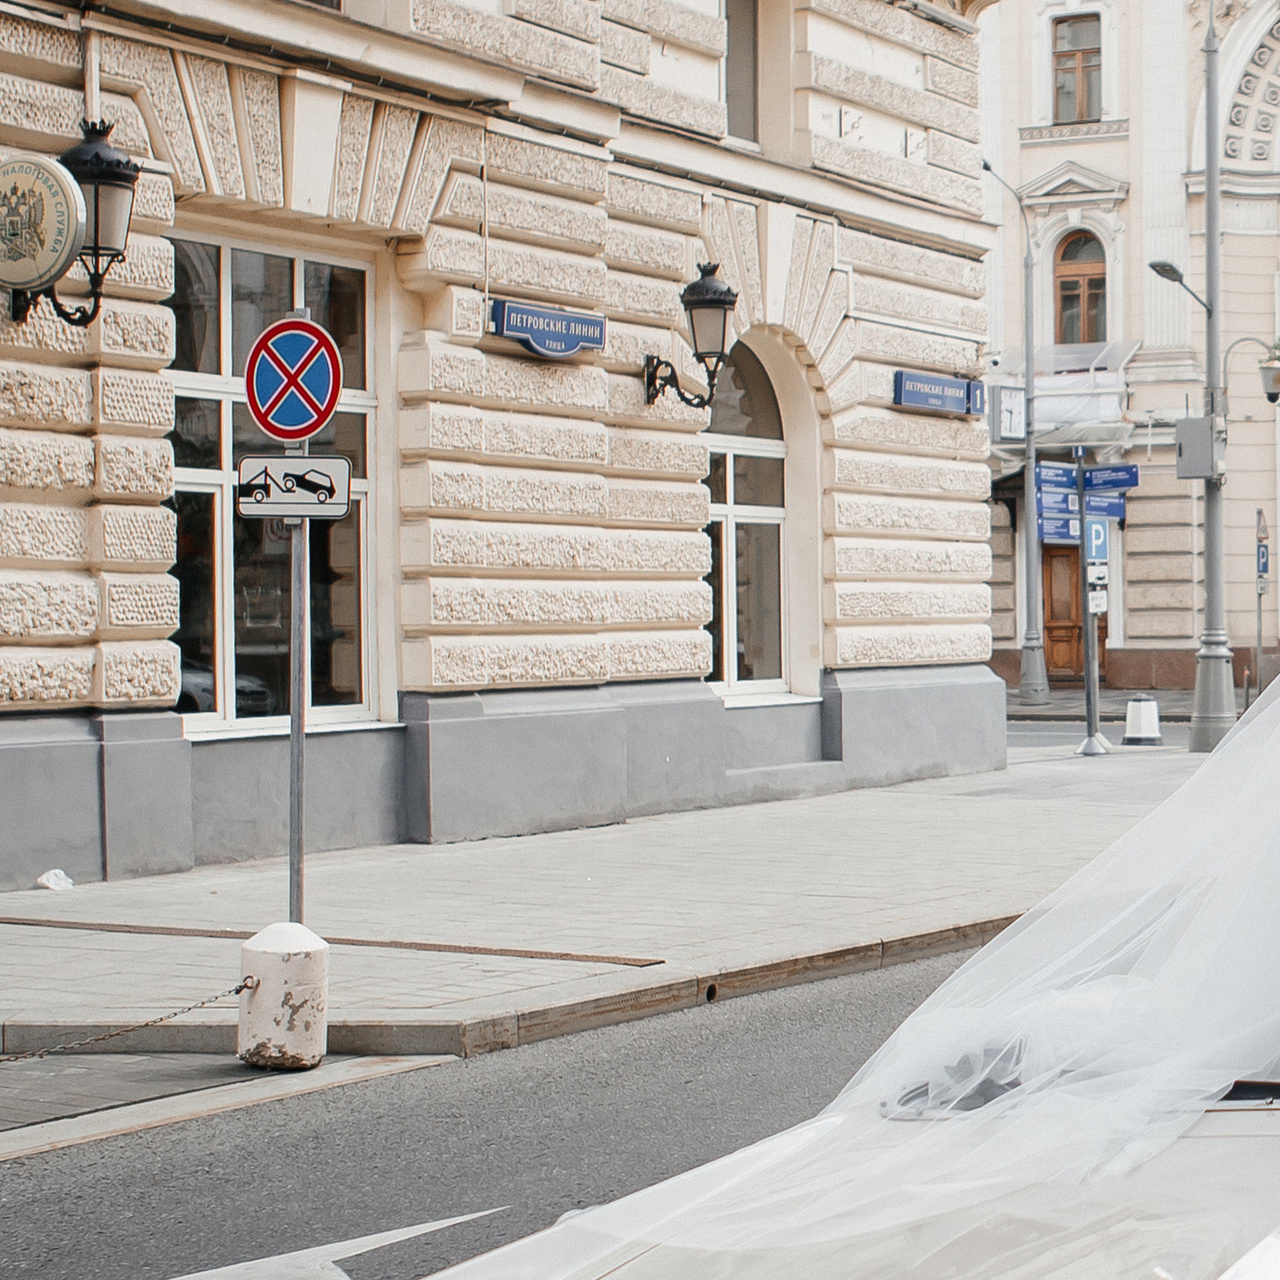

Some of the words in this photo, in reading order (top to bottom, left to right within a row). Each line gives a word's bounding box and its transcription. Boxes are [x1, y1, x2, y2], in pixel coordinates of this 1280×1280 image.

[2, 164, 60, 199] НАЛОГОВАЯ
[50, 201, 66, 254] СЛУЖБА
[510, 312, 567, 334] ПЕТРОВСКИЕ
[569, 322, 600, 339] ЛИНИИ
[975, 388, 981, 409] 1
[1091, 523, 1105, 557] P
[1259, 546, 1267, 571] P
